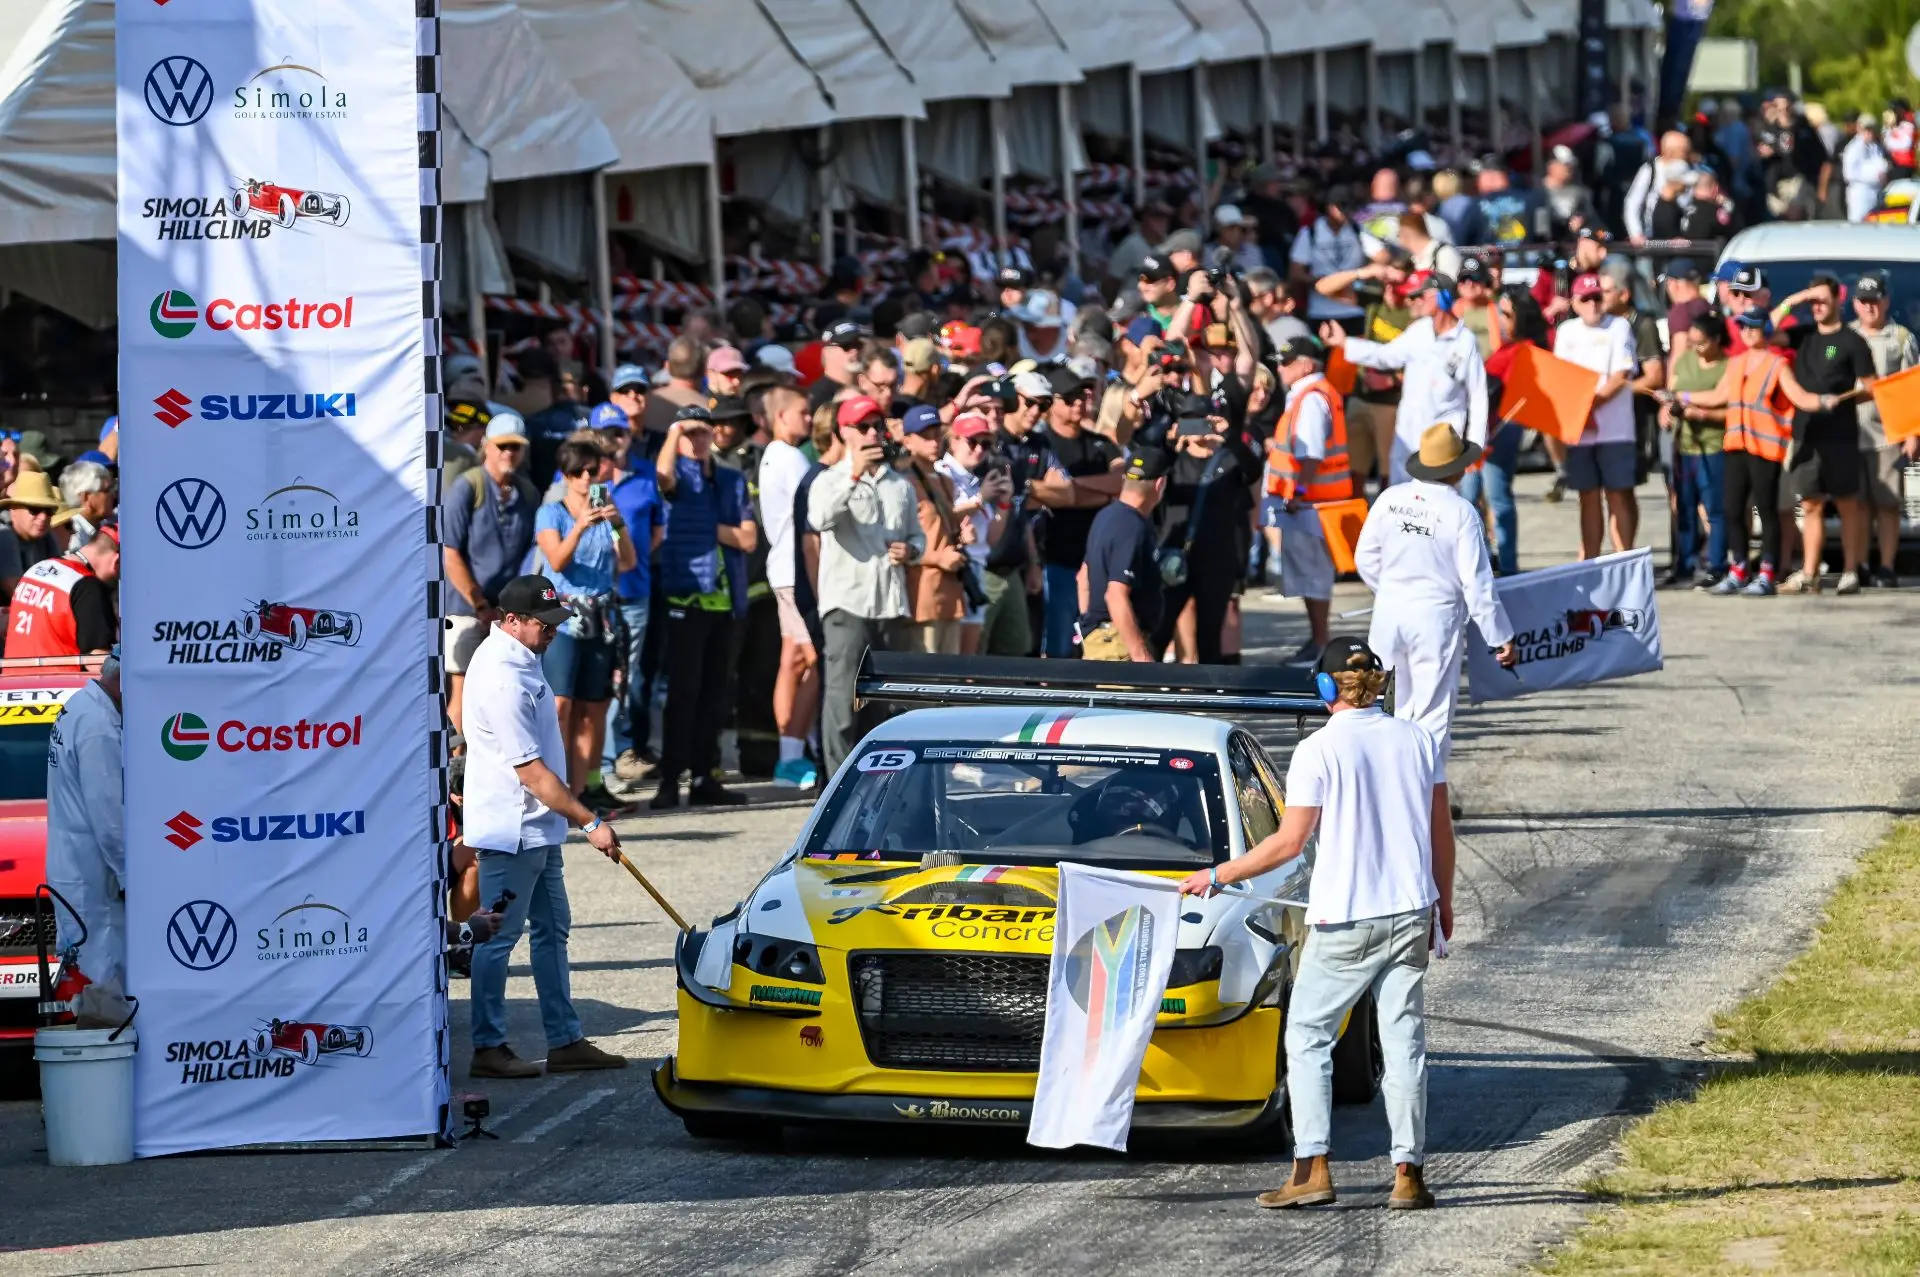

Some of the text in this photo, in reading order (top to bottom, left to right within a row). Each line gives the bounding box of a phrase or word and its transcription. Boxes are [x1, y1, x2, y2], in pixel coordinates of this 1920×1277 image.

[234, 86, 347, 108] Simola
[234, 111, 348, 119] GOLF & COUNTRY ESTATE
[142, 198, 227, 218] SIMOLA
[307, 199, 318, 209] 14
[157, 219, 271, 240] HILLCLIMB
[205, 296, 354, 331] Castrol
[200, 393, 356, 420] SUZUKI
[246, 505, 359, 530] Simola
[246, 529, 359, 541] GOLF & COUNTRY ESTATE
[15, 610, 33, 636] 21
[152, 620, 239, 642] SIMOLA
[319, 618, 330, 629] 14
[168, 642, 283, 664] HILLCLIMB
[217, 715, 362, 752] Castrol
[869, 753, 906, 767] 15
[211, 810, 365, 842] SUZUKI
[257, 922, 369, 950] Simola
[257, 944, 369, 961] GOLF & COUNTRY ESTATE
[330, 1033, 341, 1044] 14
[801, 1037, 824, 1048] TOW
[165, 1039, 250, 1062] SIMOLA
[180, 1057, 296, 1084] HILLCLIMB
[930, 1100, 1021, 1120] BRONSCOR
